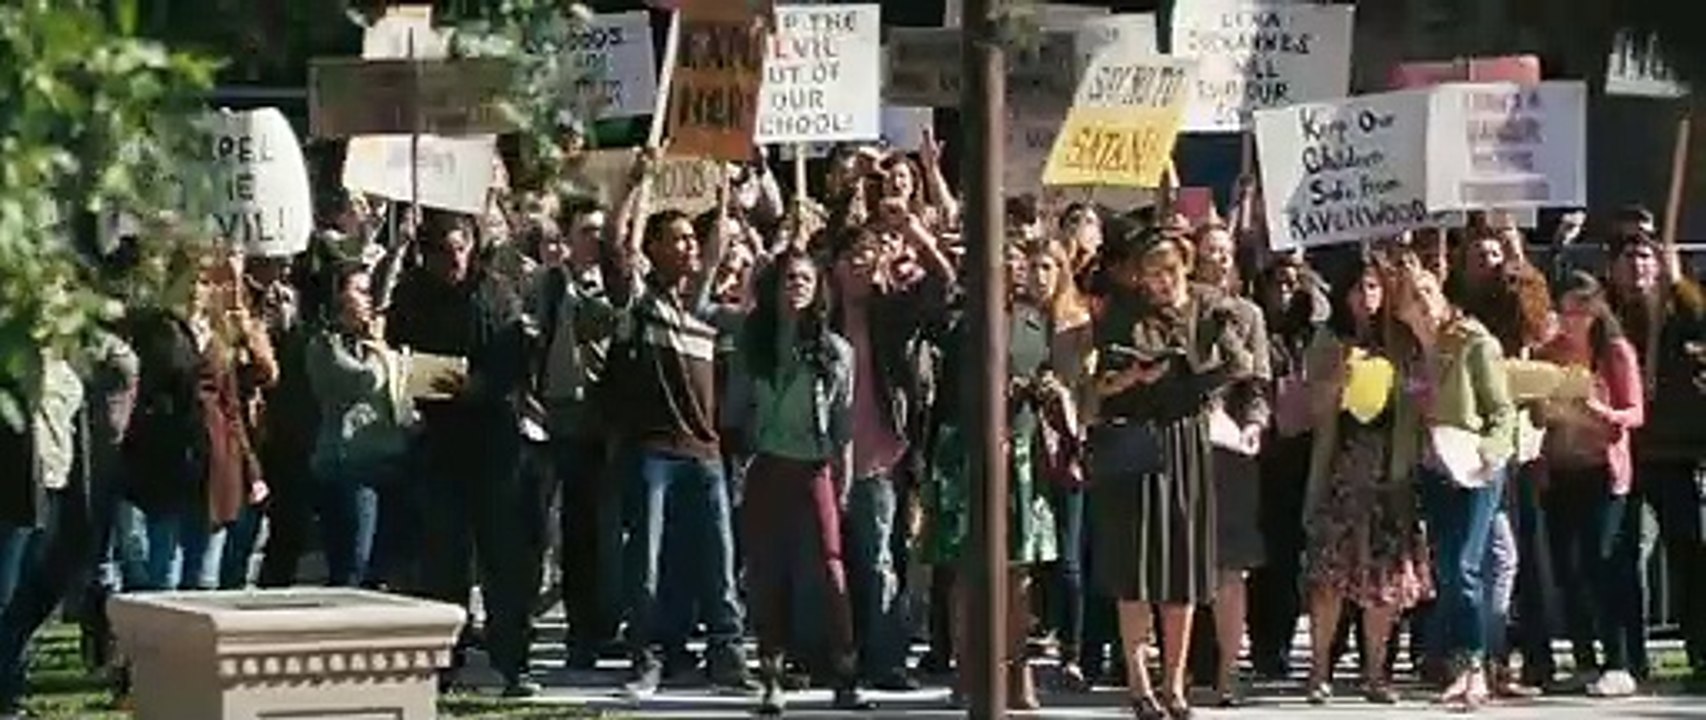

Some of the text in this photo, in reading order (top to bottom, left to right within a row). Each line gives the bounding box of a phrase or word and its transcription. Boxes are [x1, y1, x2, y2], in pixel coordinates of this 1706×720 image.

[768, 65, 800, 84] UT
[771, 89, 825, 110] OUR
[218, 135, 273, 163] PEL
[1289, 197, 1428, 241] RAVENWOOD
